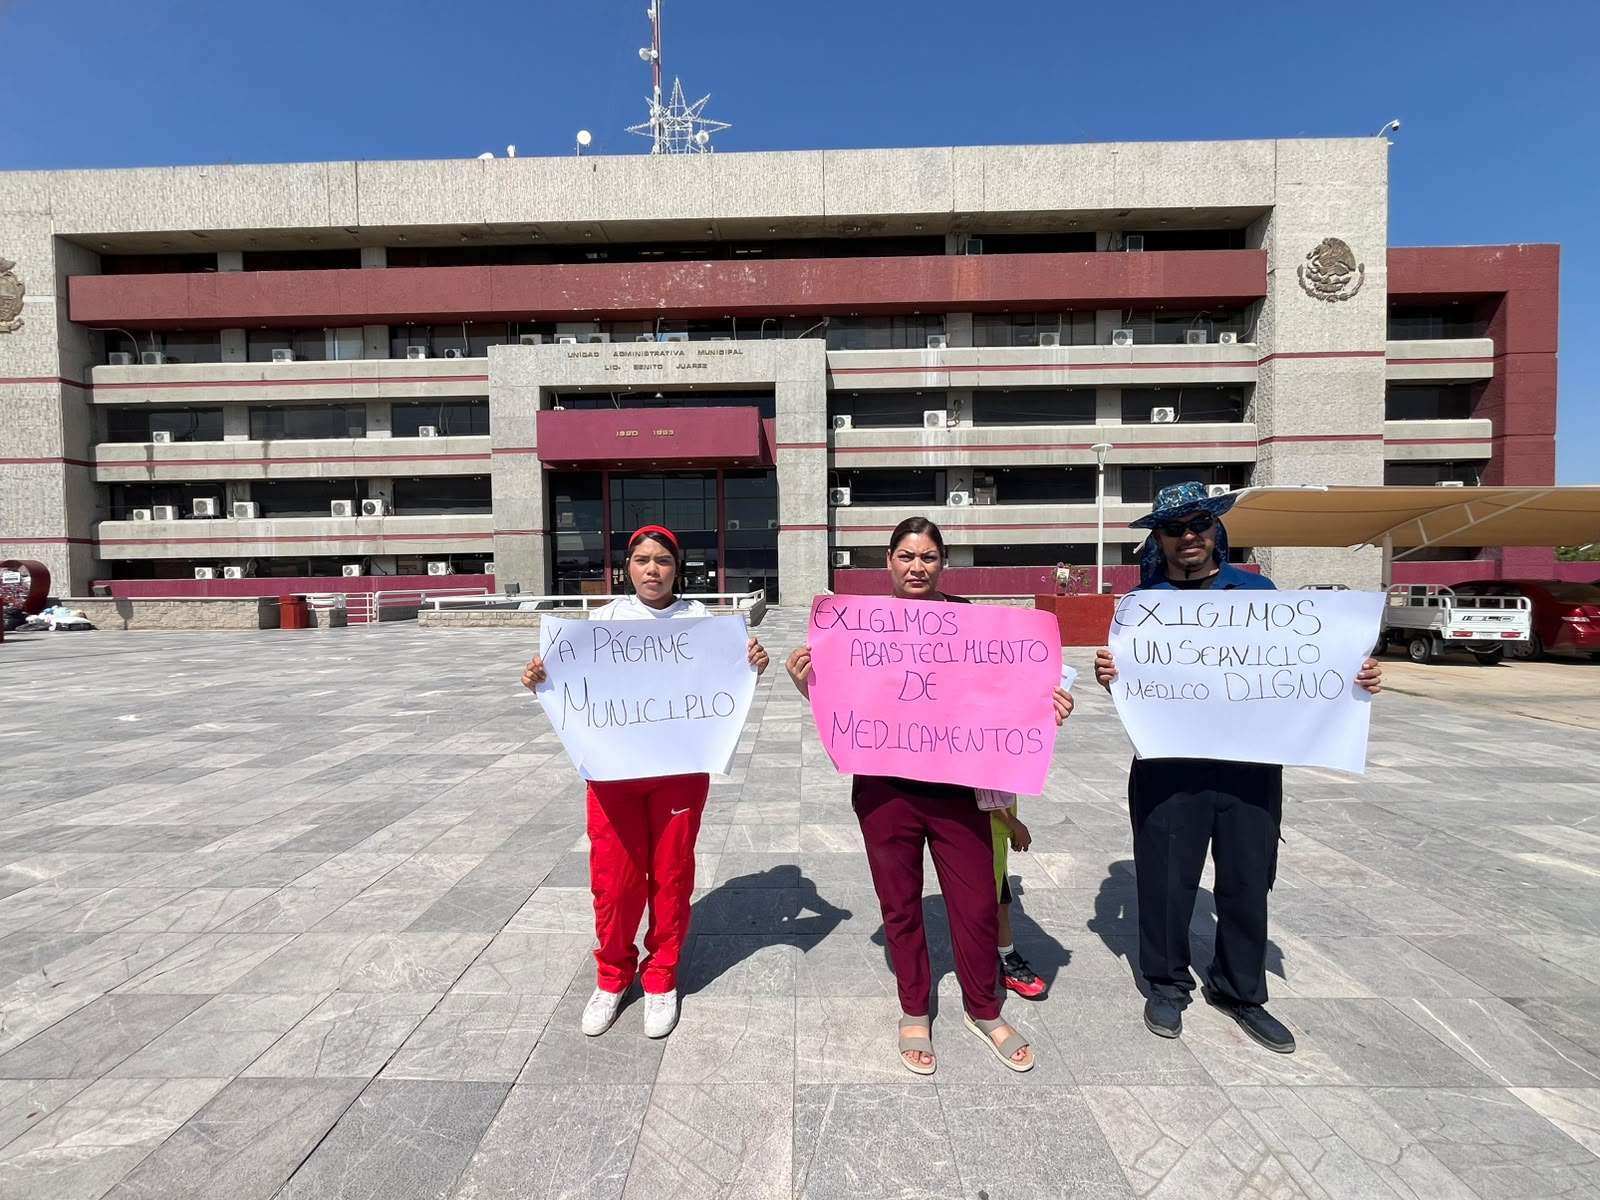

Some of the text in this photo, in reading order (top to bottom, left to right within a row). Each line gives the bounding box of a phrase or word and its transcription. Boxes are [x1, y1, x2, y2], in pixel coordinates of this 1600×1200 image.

[633, 363, 663, 371] BENITO
[813, 598, 959, 636] EXIGIMOS
[1114, 594, 1322, 636] EXIGIMOS
[592, 626, 694, 664] PÁGAME
[850, 638, 1049, 667] ABASTECIMIENTO
[562, 676, 736, 730] MUNICIPIO
[898, 670, 938, 701] DE
[1124, 669, 1344, 702] MÉDICO DIGNO
[831, 710, 1044, 756] MEDICAMENTOS
